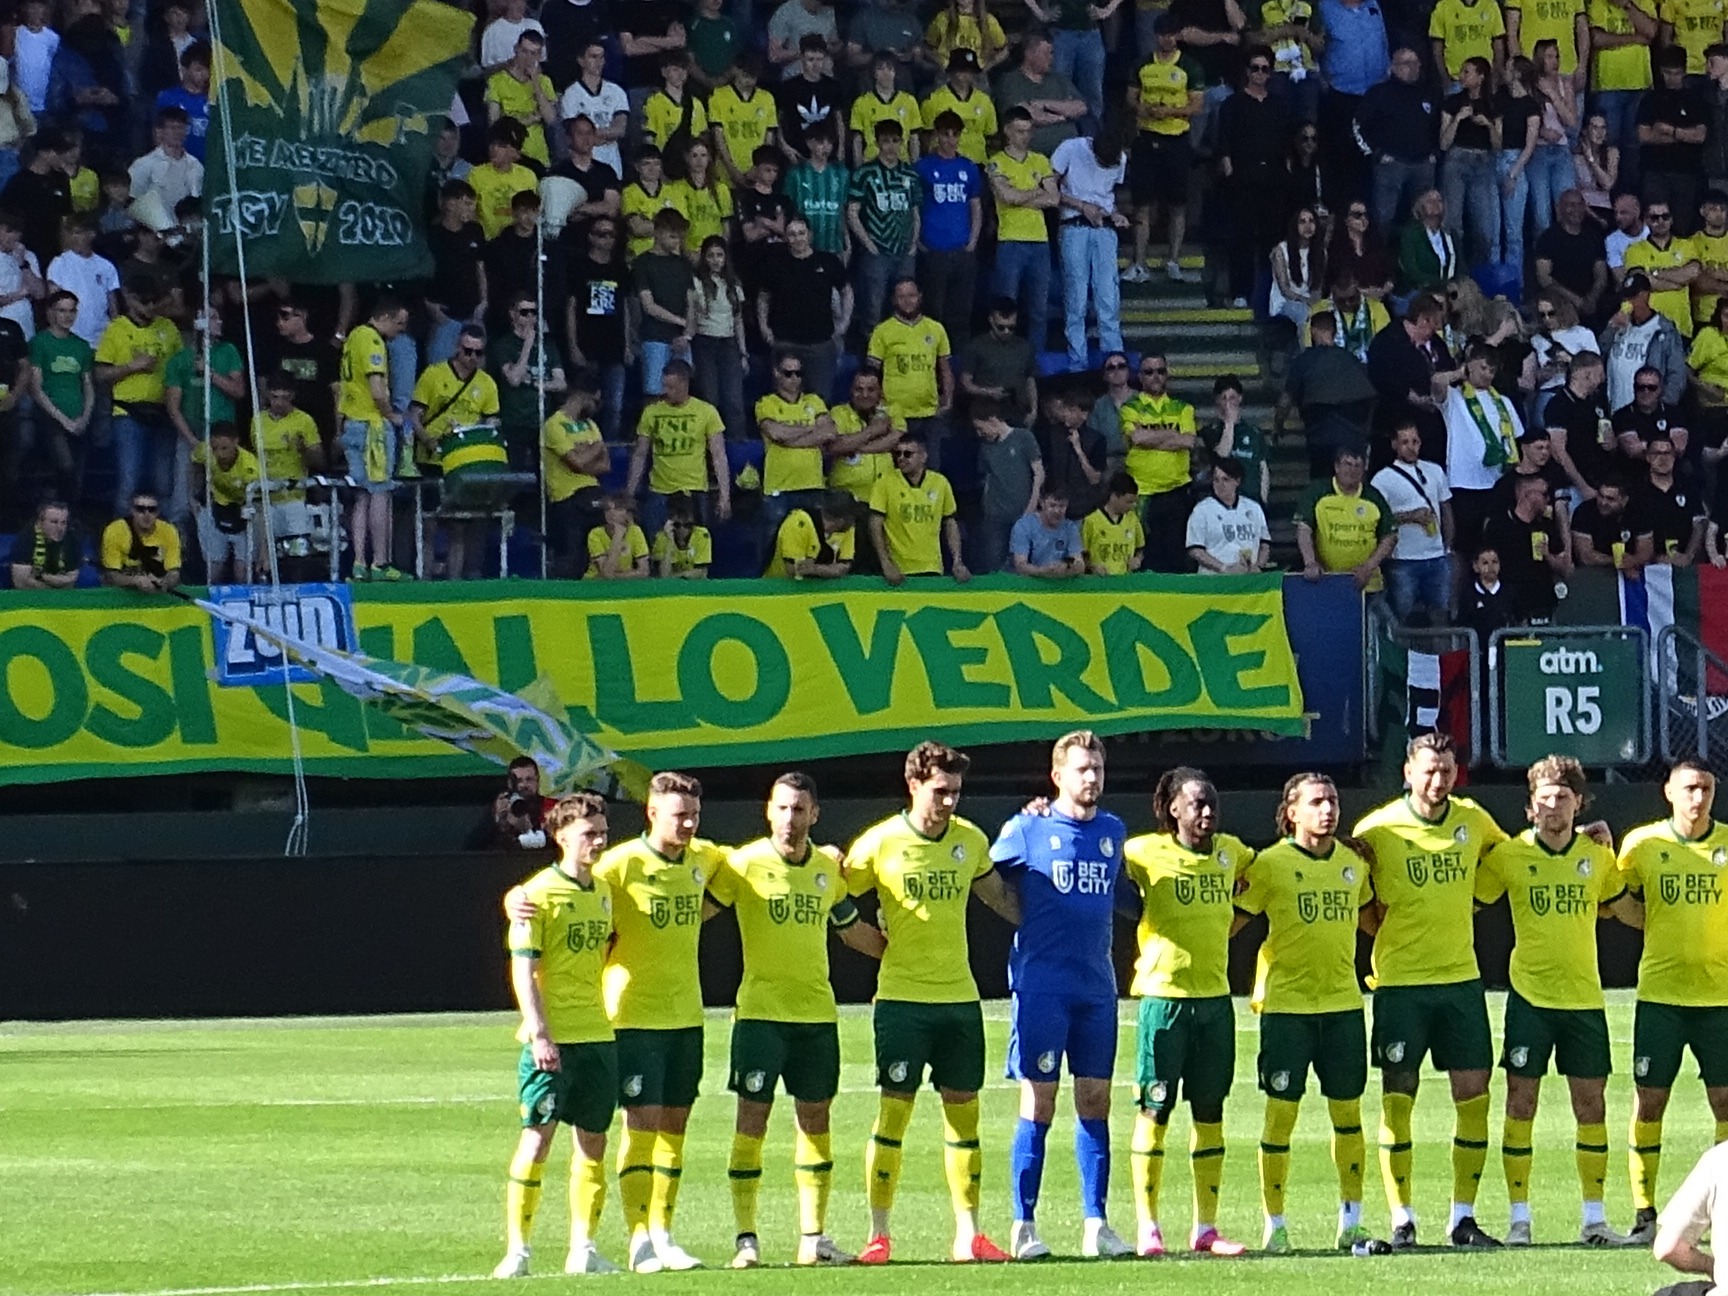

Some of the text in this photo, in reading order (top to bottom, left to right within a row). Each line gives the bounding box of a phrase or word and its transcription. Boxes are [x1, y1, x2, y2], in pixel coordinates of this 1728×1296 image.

[810, 600, 1291, 717] VERDE
[1540, 647, 1604, 675] atm.
[1545, 686, 1602, 735] R5
[928, 870, 958, 886] BET
[1078, 861, 1109, 879] BET
[1078, 878, 1112, 896] CITY
[1200, 874, 1226, 889] BET
[1685, 874, 1719, 890] BET
[928, 885, 963, 901] CITY
[1200, 889, 1231, 905] CITY
[1323, 890, 1352, 907] BET
[1556, 884, 1587, 900] BET
[1685, 889, 1723, 906] CITY
[1323, 905, 1355, 923] CITY
[1556, 899, 1592, 916] CITY
[674, 910, 701, 926] CIT
[587, 936, 609, 951] CI
